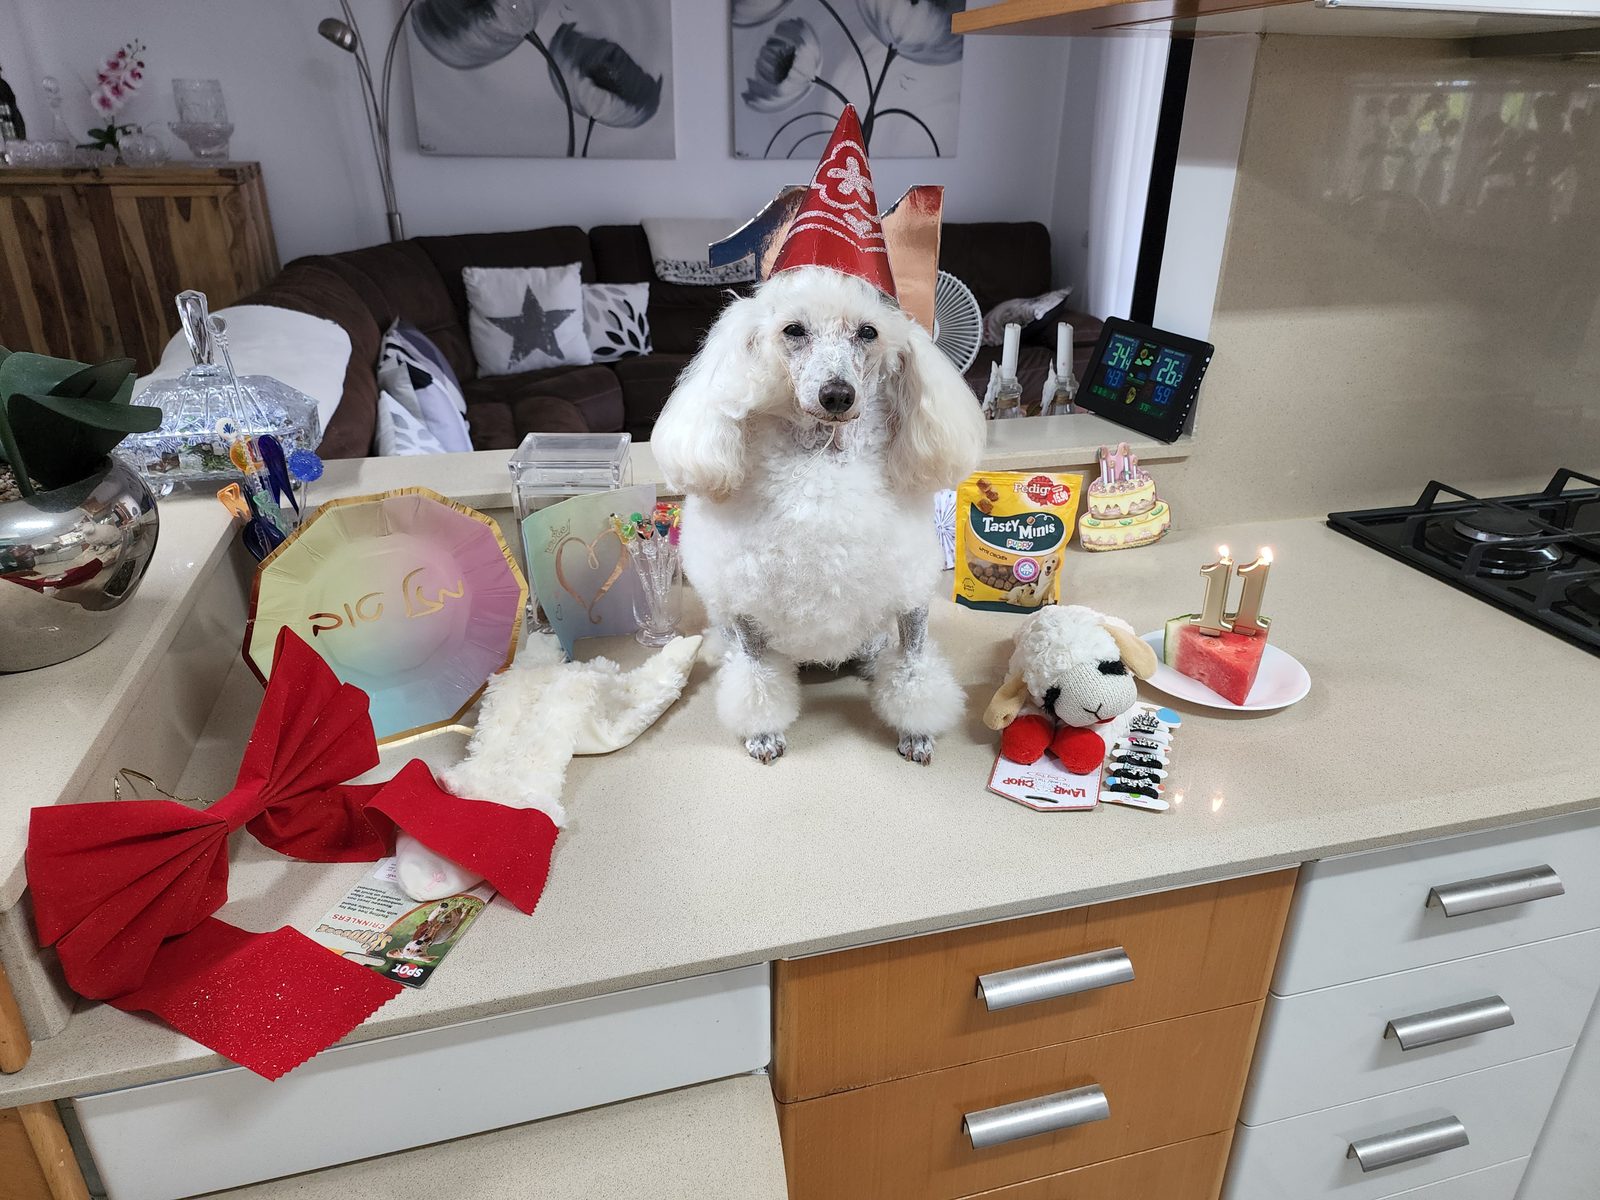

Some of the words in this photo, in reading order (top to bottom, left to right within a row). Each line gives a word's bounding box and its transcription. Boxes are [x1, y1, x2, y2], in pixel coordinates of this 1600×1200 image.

[1154, 385, 1170, 404] 59
[982, 516, 1020, 533] Tasty
[1018, 522, 1056, 540] Minis
[1006, 538, 1034, 550] puppy
[307, 591, 384, 637] טוב
[1002, 777, 1035, 787] CHOP
[1053, 784, 1086, 798] LAMB
[332, 913, 386, 929] CRINKLERS
[368, 911, 389, 919] Stuffing
[392, 963, 424, 978] SPOT
